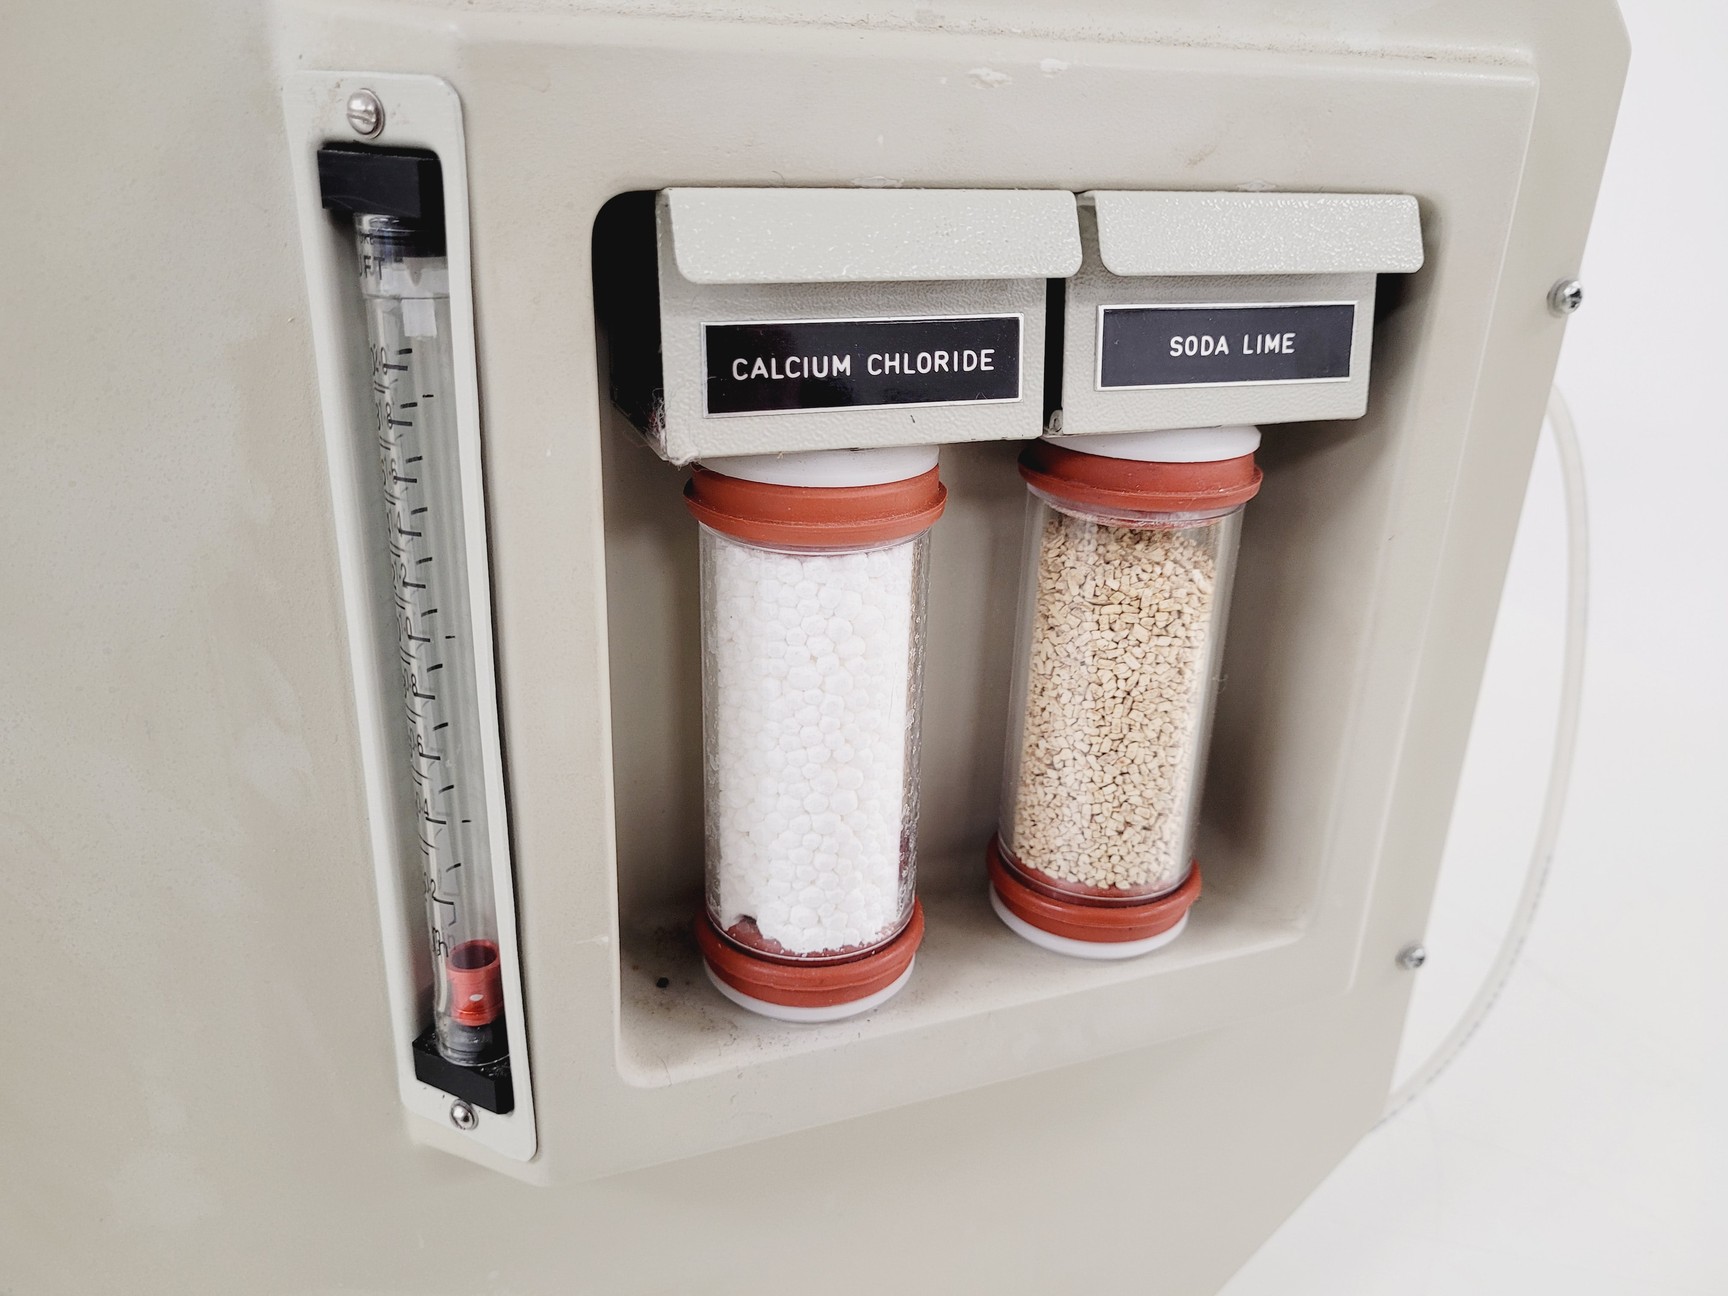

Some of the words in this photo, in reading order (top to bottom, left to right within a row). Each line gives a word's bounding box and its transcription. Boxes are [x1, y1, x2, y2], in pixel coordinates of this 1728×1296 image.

[1169, 335, 1230, 357] SODA
[1242, 332, 1296, 355] LIME
[732, 354, 851, 380] CALCIUM
[867, 348, 995, 376] CHLORIDE
